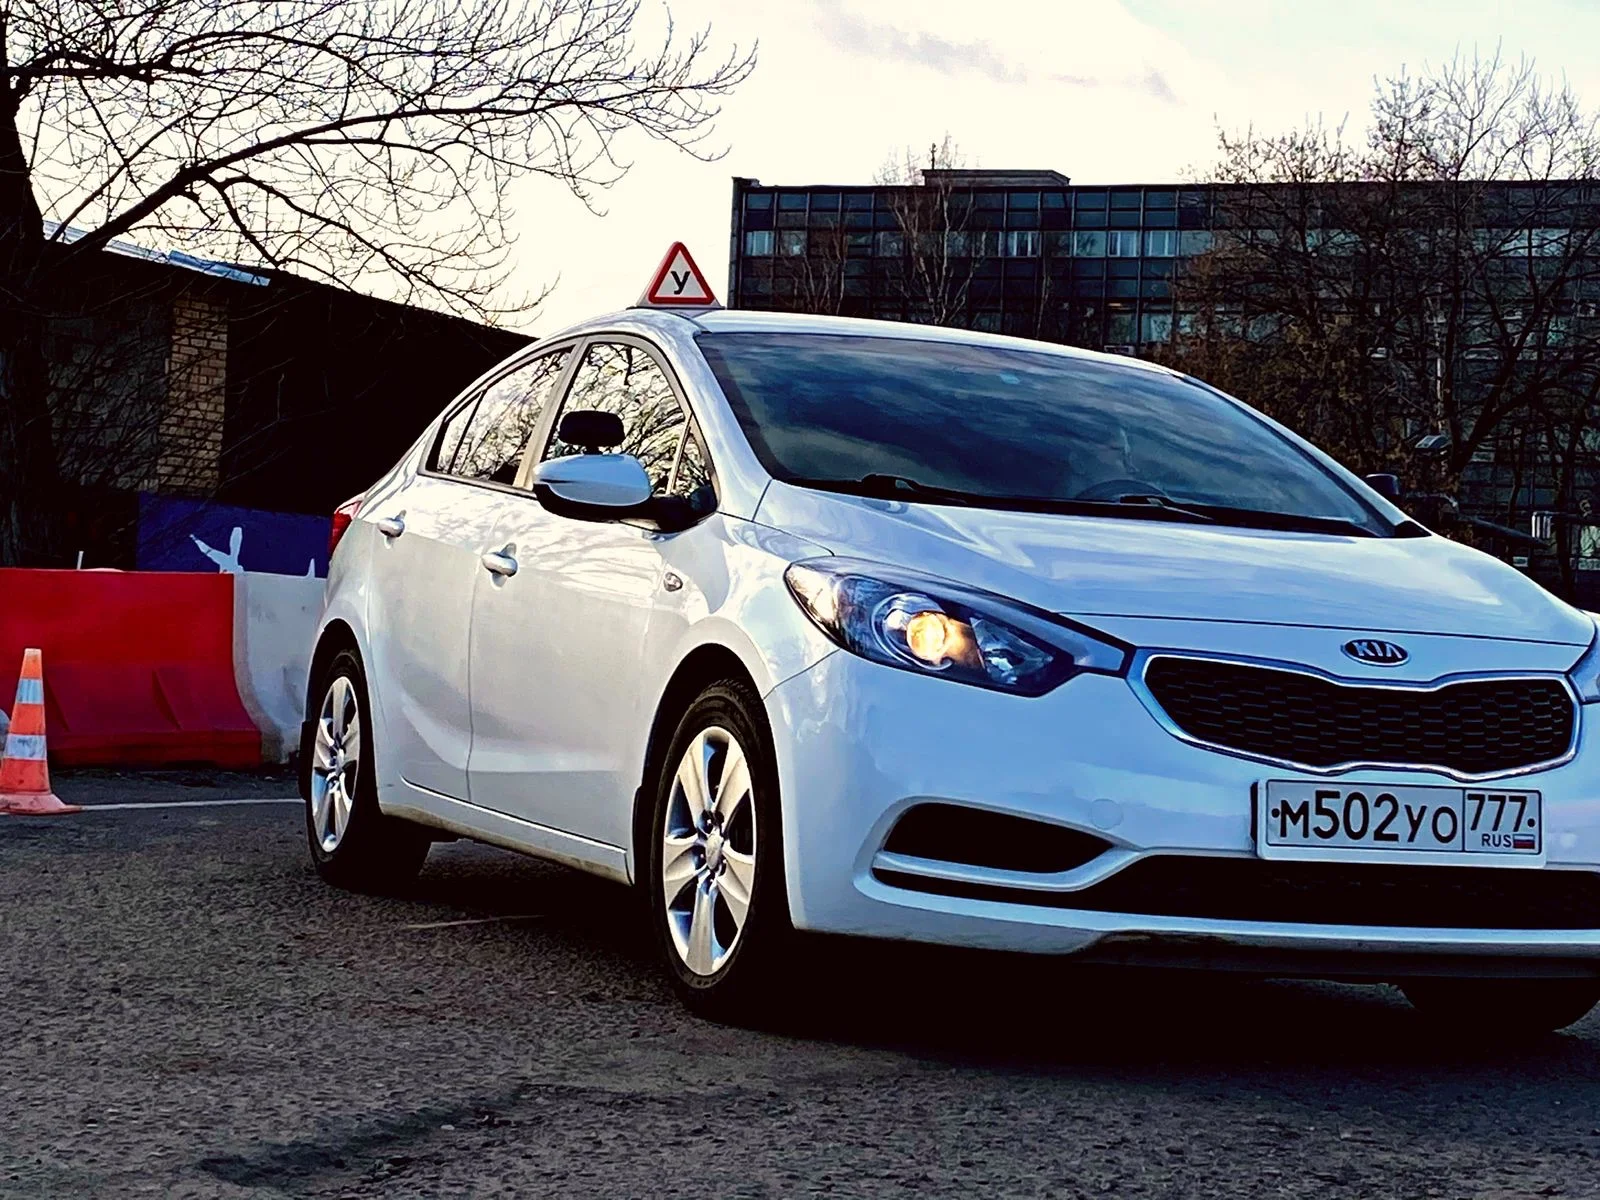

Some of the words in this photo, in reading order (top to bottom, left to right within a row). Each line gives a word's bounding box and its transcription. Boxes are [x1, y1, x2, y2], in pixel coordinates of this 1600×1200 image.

[1351, 641, 1403, 659] KIA
[1466, 793, 1528, 833] 777
[1481, 833, 1512, 848] RUS
